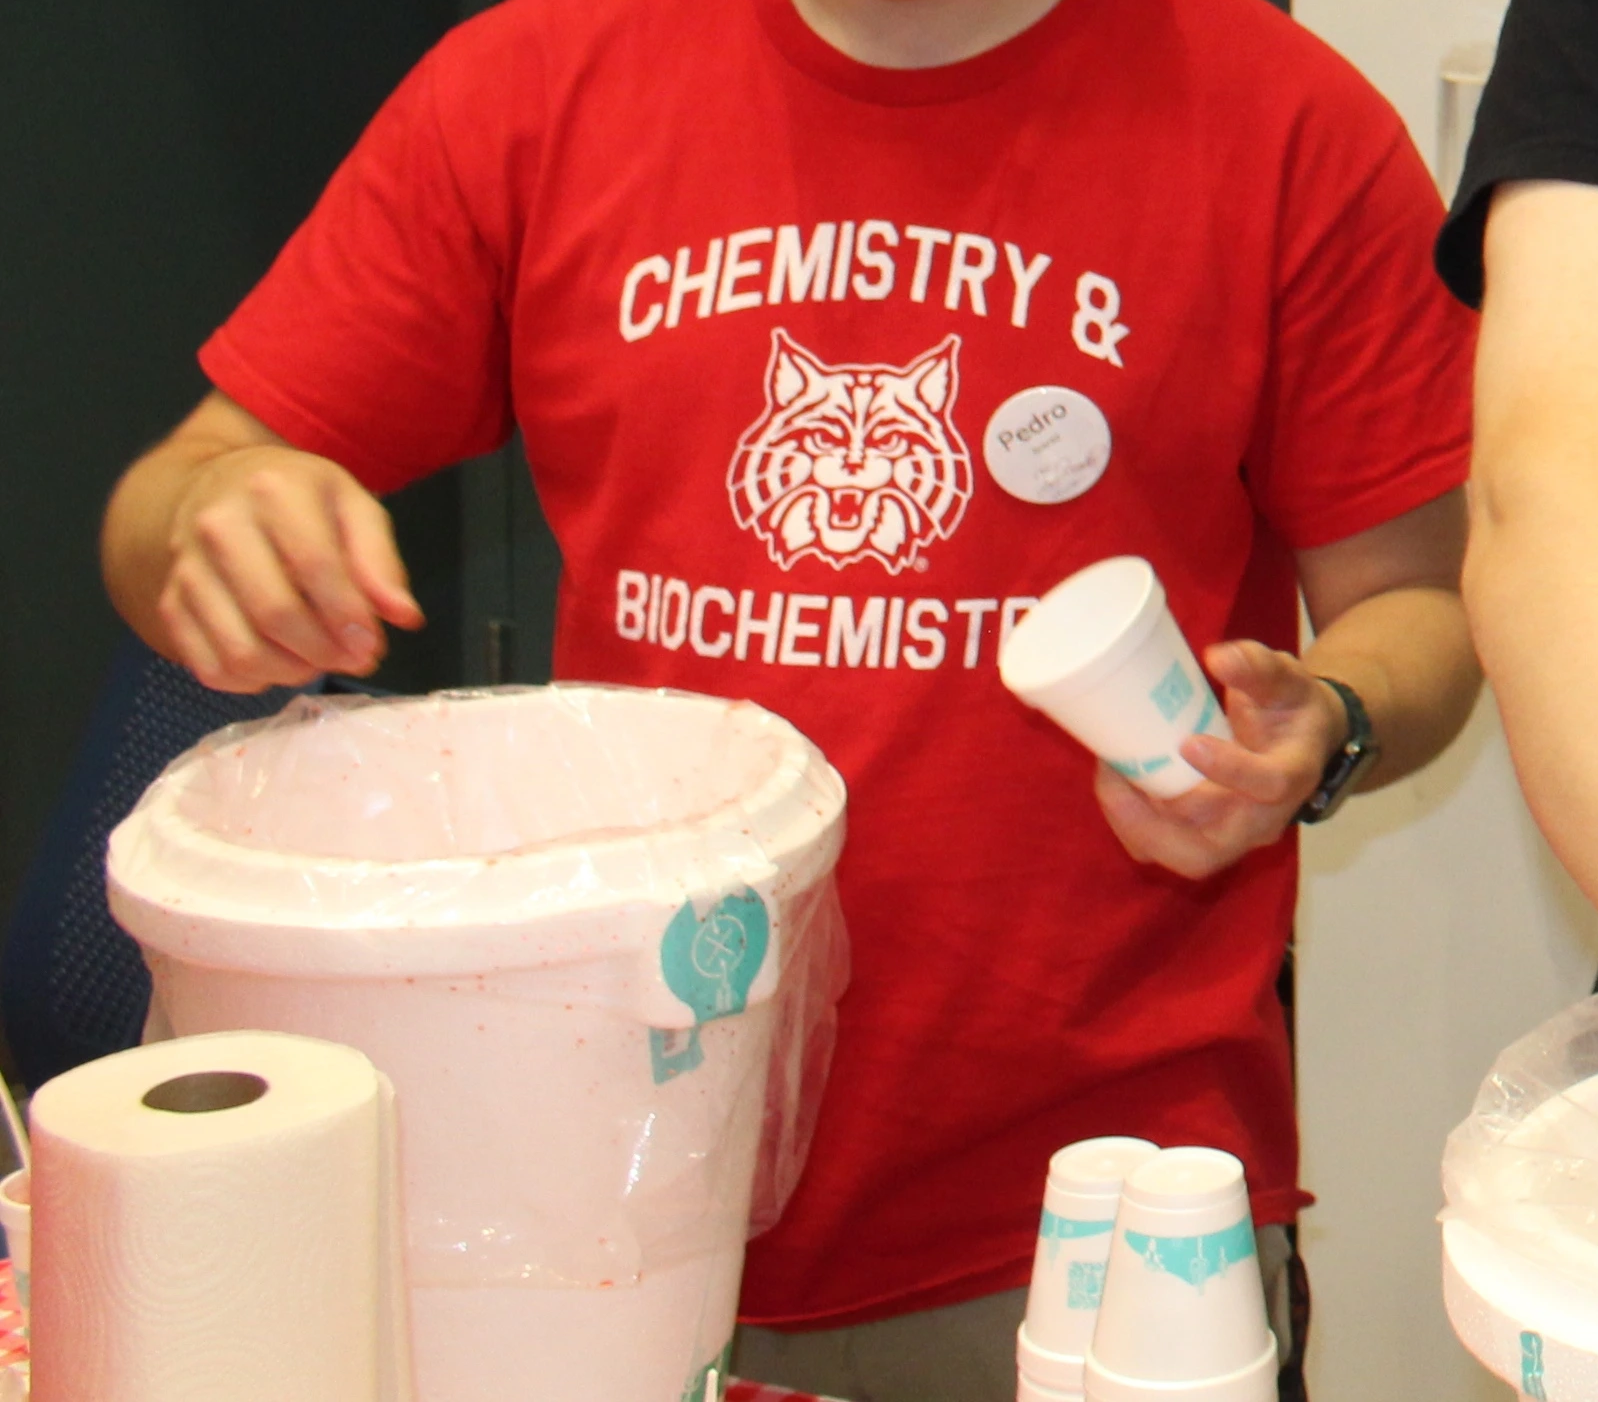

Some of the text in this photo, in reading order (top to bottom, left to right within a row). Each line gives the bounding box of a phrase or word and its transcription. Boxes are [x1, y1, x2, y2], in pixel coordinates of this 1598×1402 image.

[619, 219, 1130, 368] CHEMISTRY &
[998, 404, 1067, 453] Pedro
